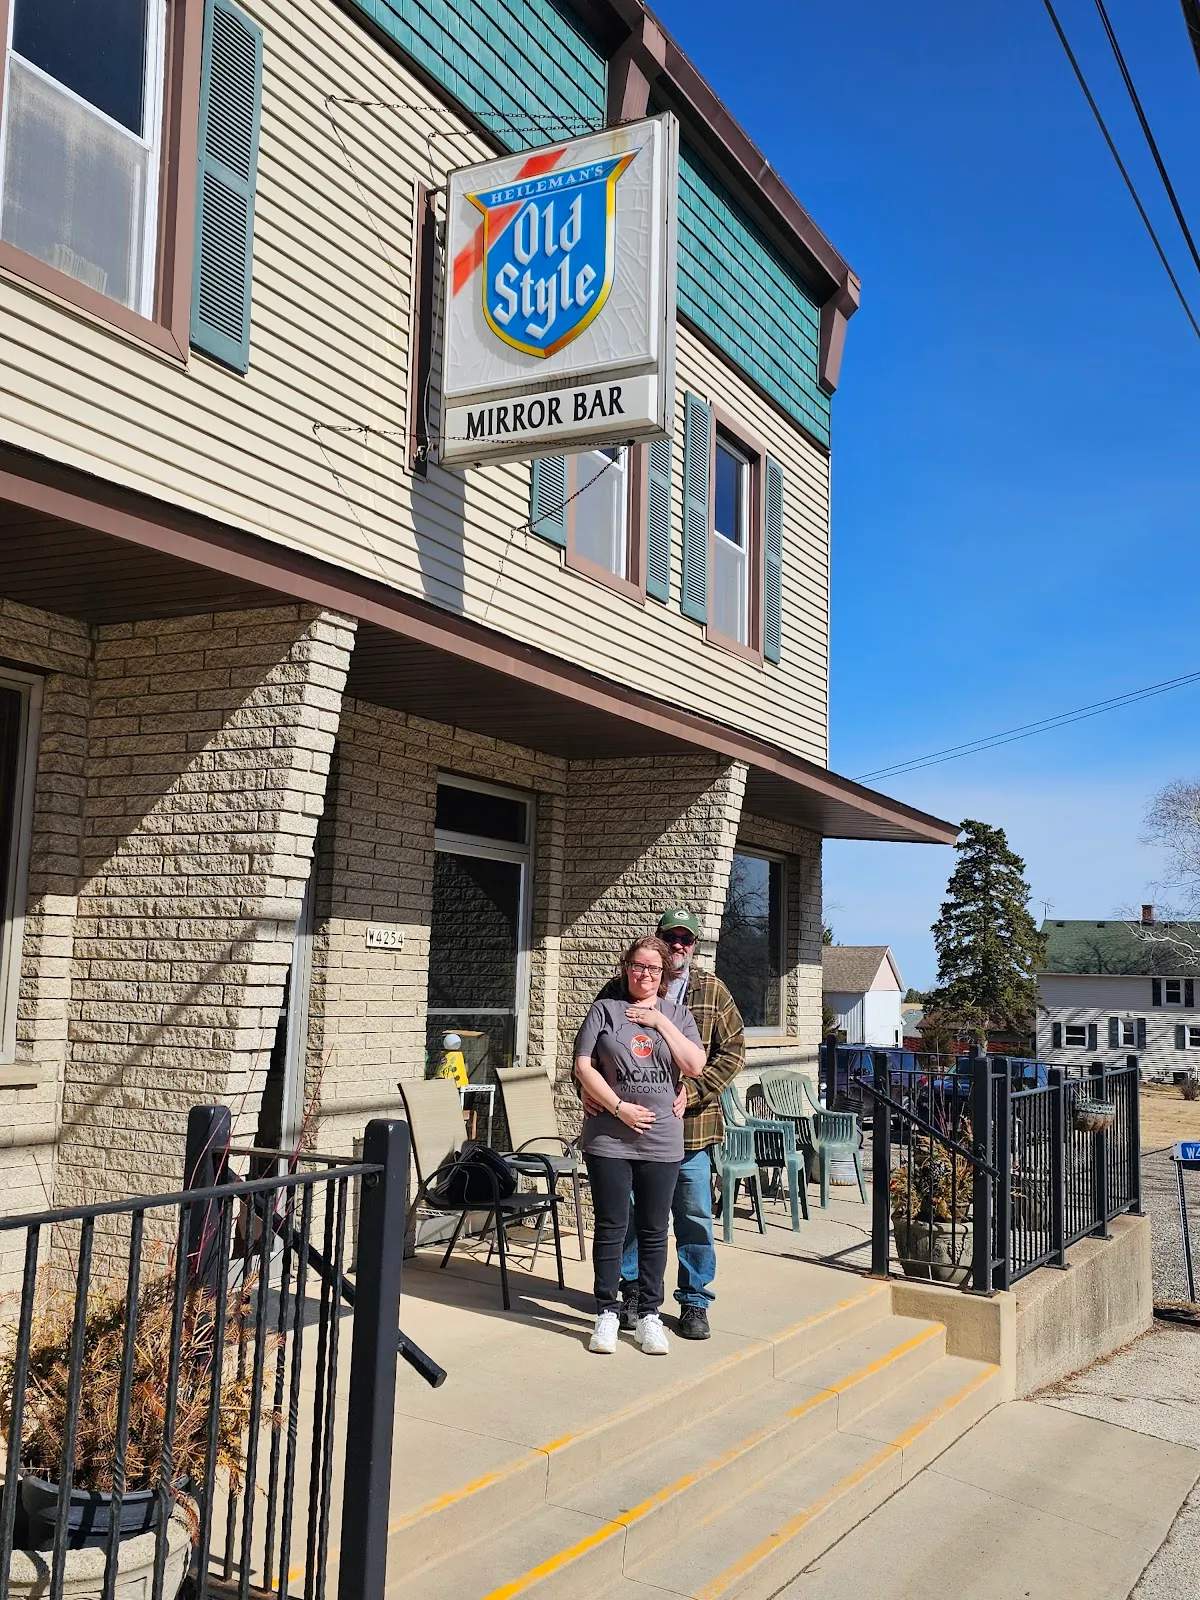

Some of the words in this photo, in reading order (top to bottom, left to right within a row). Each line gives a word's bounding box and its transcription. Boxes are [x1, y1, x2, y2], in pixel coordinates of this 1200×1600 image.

[490, 165, 604, 205] HEILEMAN'S
[513, 193, 583, 266] Old
[492, 254, 597, 339] Style
[466, 397, 564, 439] MIRROR
[572, 386, 625, 421] BAR
[368, 929, 404, 946] W4254
[616, 1068, 670, 1083] BACARDI
